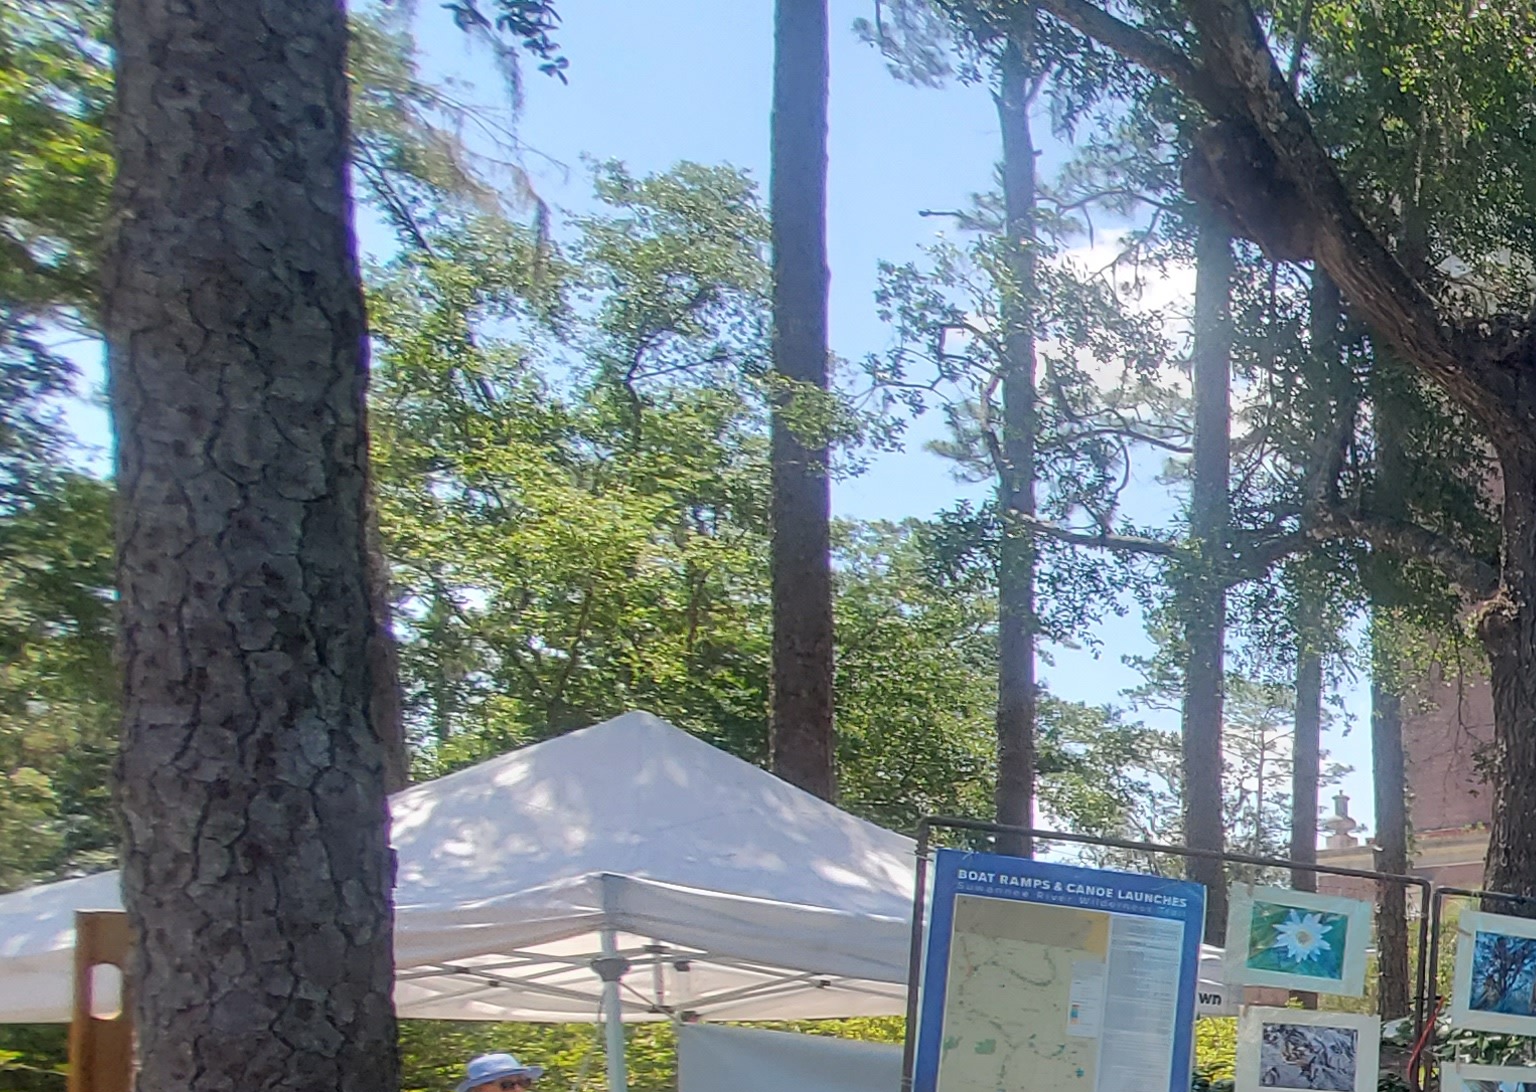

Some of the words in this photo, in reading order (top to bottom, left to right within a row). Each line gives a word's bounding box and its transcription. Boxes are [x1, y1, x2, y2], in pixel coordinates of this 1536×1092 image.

[958, 869, 996, 883] BOAT
[999, 874, 1051, 890] RAMPS
[1053, 882, 1063, 892] &
[1066, 883, 1114, 898] CANOE
[1117, 890, 1188, 907] LAUNCHES
